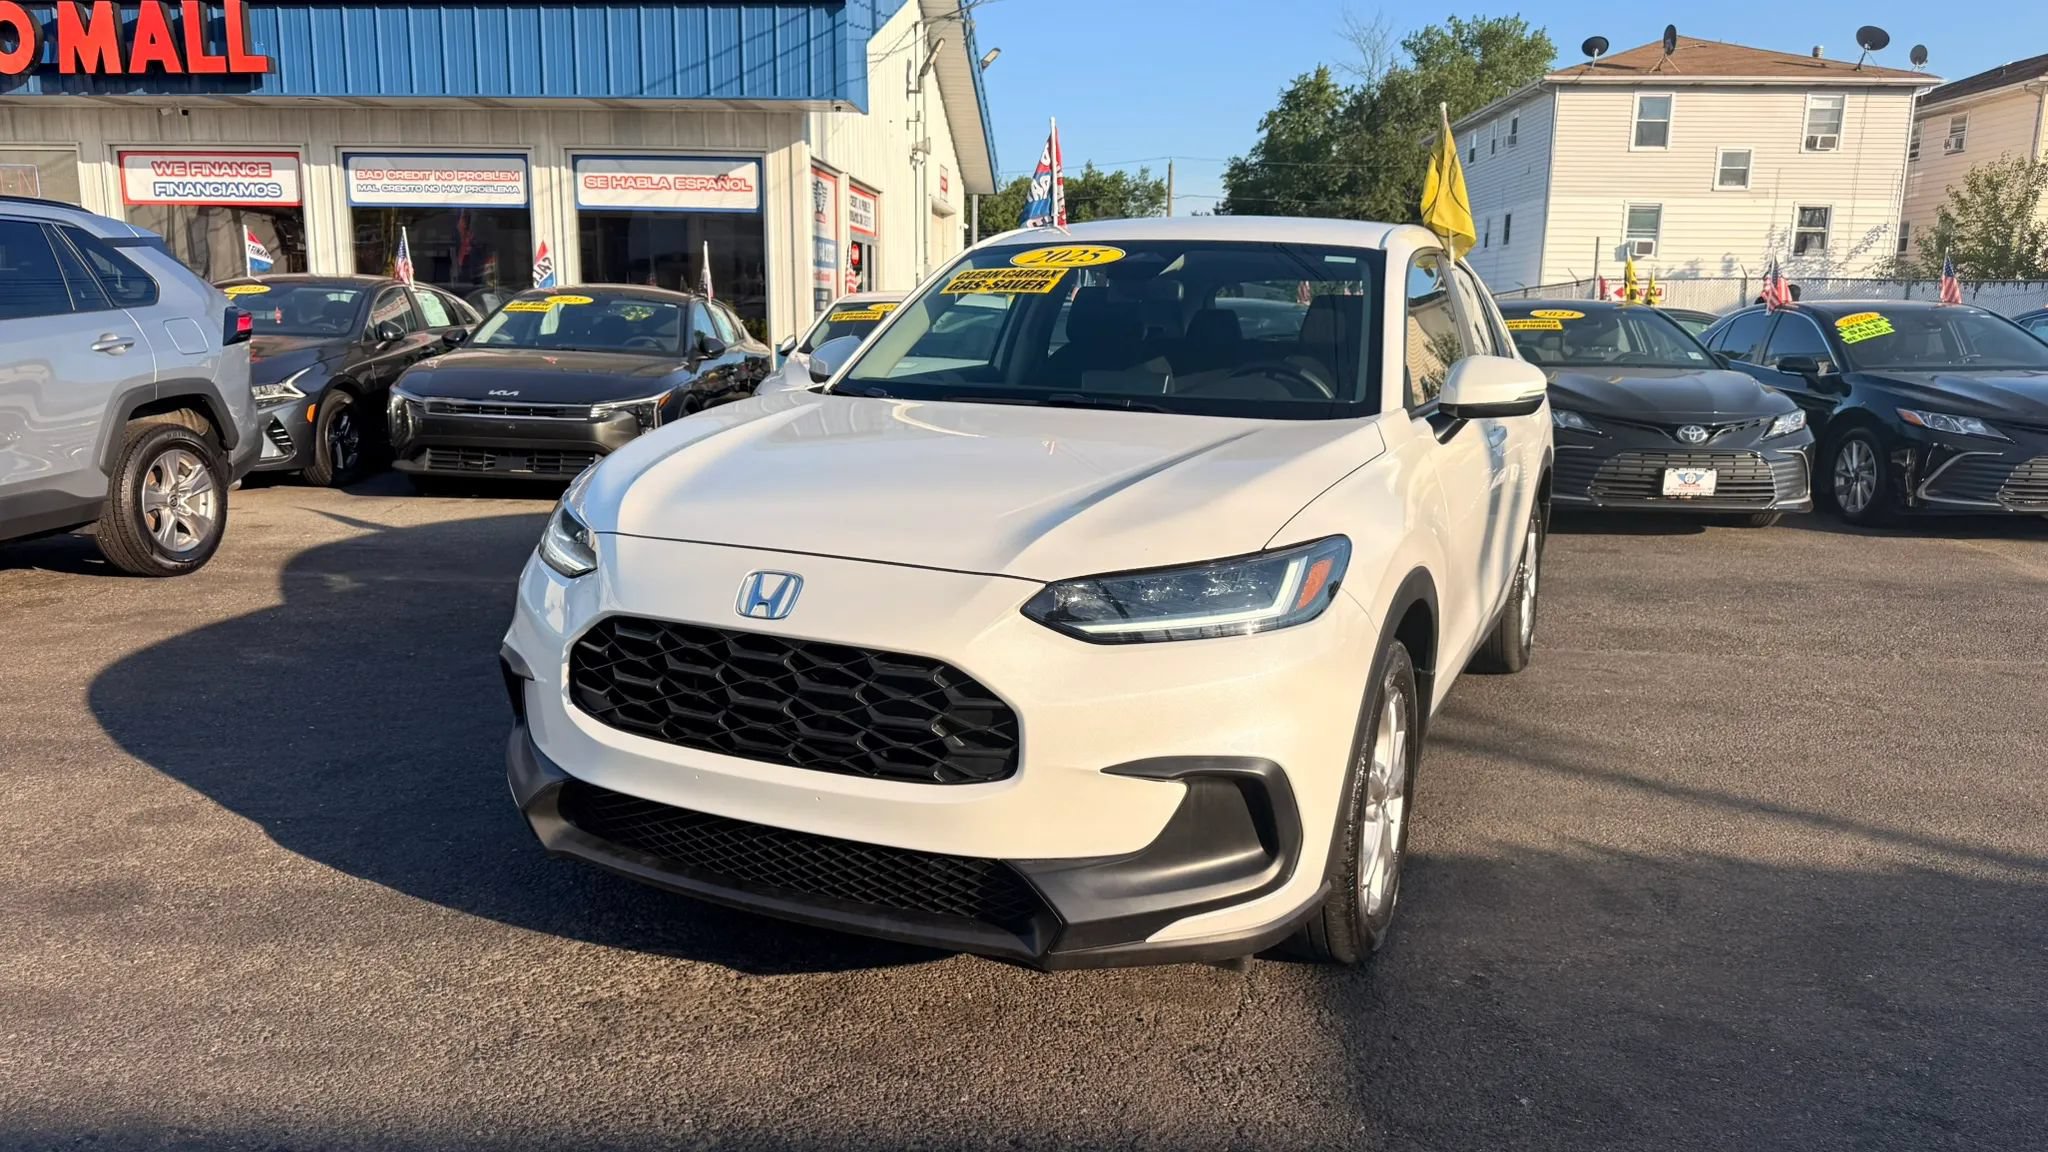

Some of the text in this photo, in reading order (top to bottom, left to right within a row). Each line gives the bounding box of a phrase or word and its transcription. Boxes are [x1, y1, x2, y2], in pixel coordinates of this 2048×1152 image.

[57, 0, 268, 74] MALL
[152, 161, 271, 177] WE FINANCE
[356, 169, 520, 182] BAD CREDIT NO PROBLEM
[153, 182, 282, 198] FINANCIAMOS
[357, 184, 380, 193] MAL
[424, 184, 440, 193] NO
[441, 184, 463, 194] HAY
[465, 185, 520, 195] PROBLEMA
[584, 174, 753, 192] SE HABLA ESPAÑOL
[1026, 248, 1112, 264] 2025
[955, 269, 1065, 281] CLEAN CARFAX
